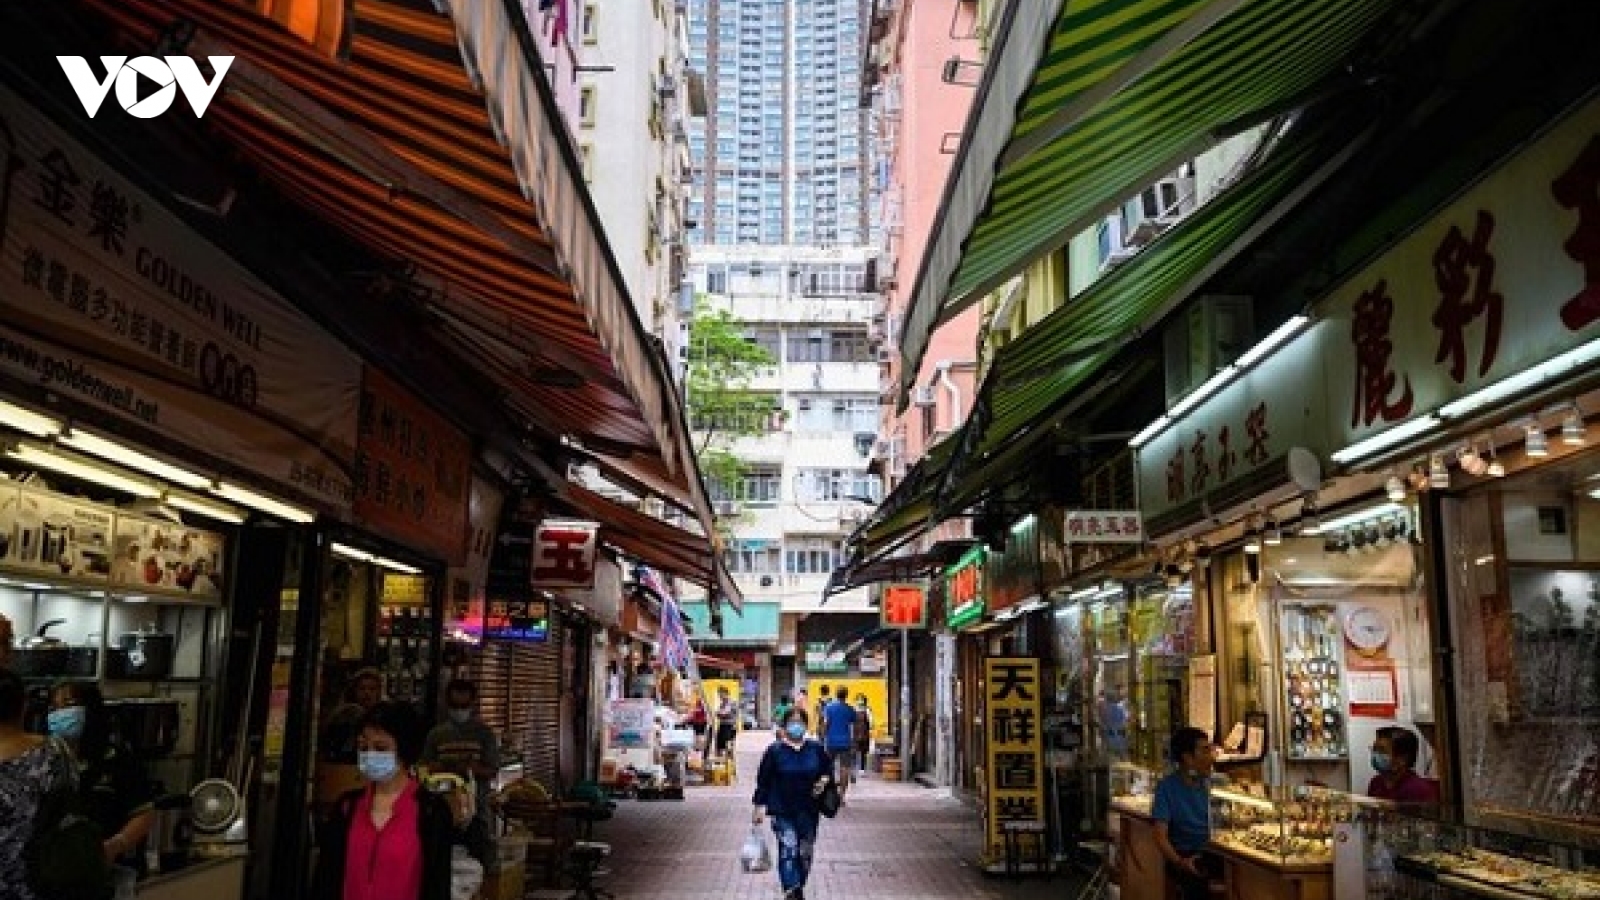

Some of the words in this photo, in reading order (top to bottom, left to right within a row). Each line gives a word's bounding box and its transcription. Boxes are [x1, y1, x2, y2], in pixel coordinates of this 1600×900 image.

[135, 246, 216, 320] GOLDEN
[222, 302, 261, 351] WELL
[533, 530, 592, 583] 玉
